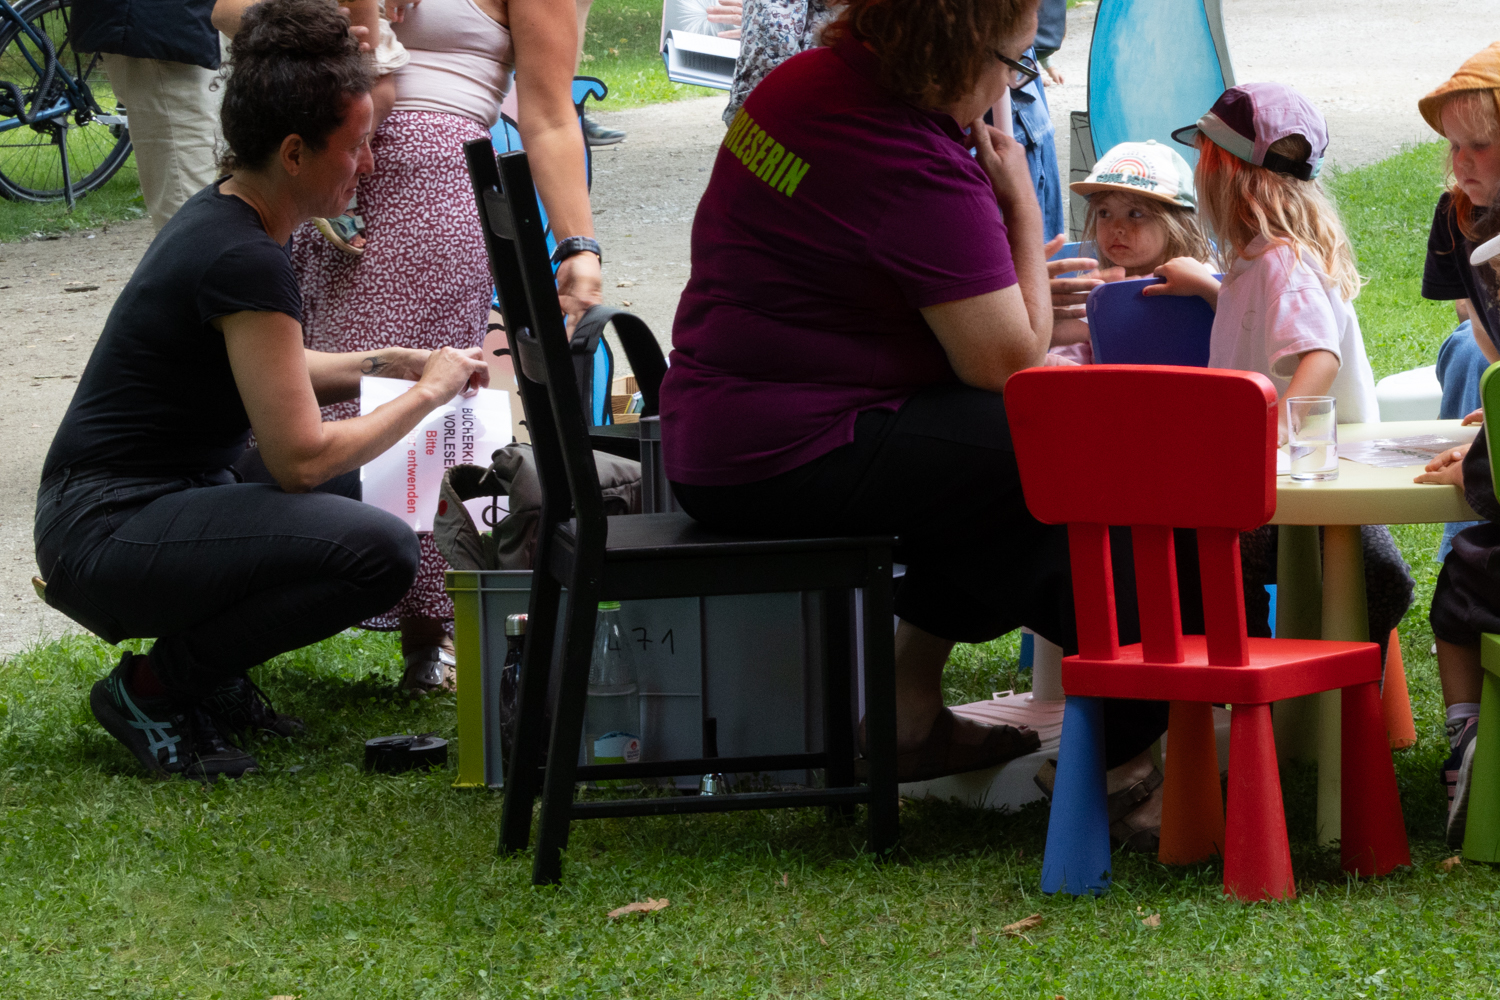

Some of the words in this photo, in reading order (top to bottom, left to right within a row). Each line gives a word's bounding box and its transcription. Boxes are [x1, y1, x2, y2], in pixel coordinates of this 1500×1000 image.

[723, 107, 811, 198] RLESERIN
[425, 430, 438, 456] Bitte
[406, 449, 419, 514] entwenden
